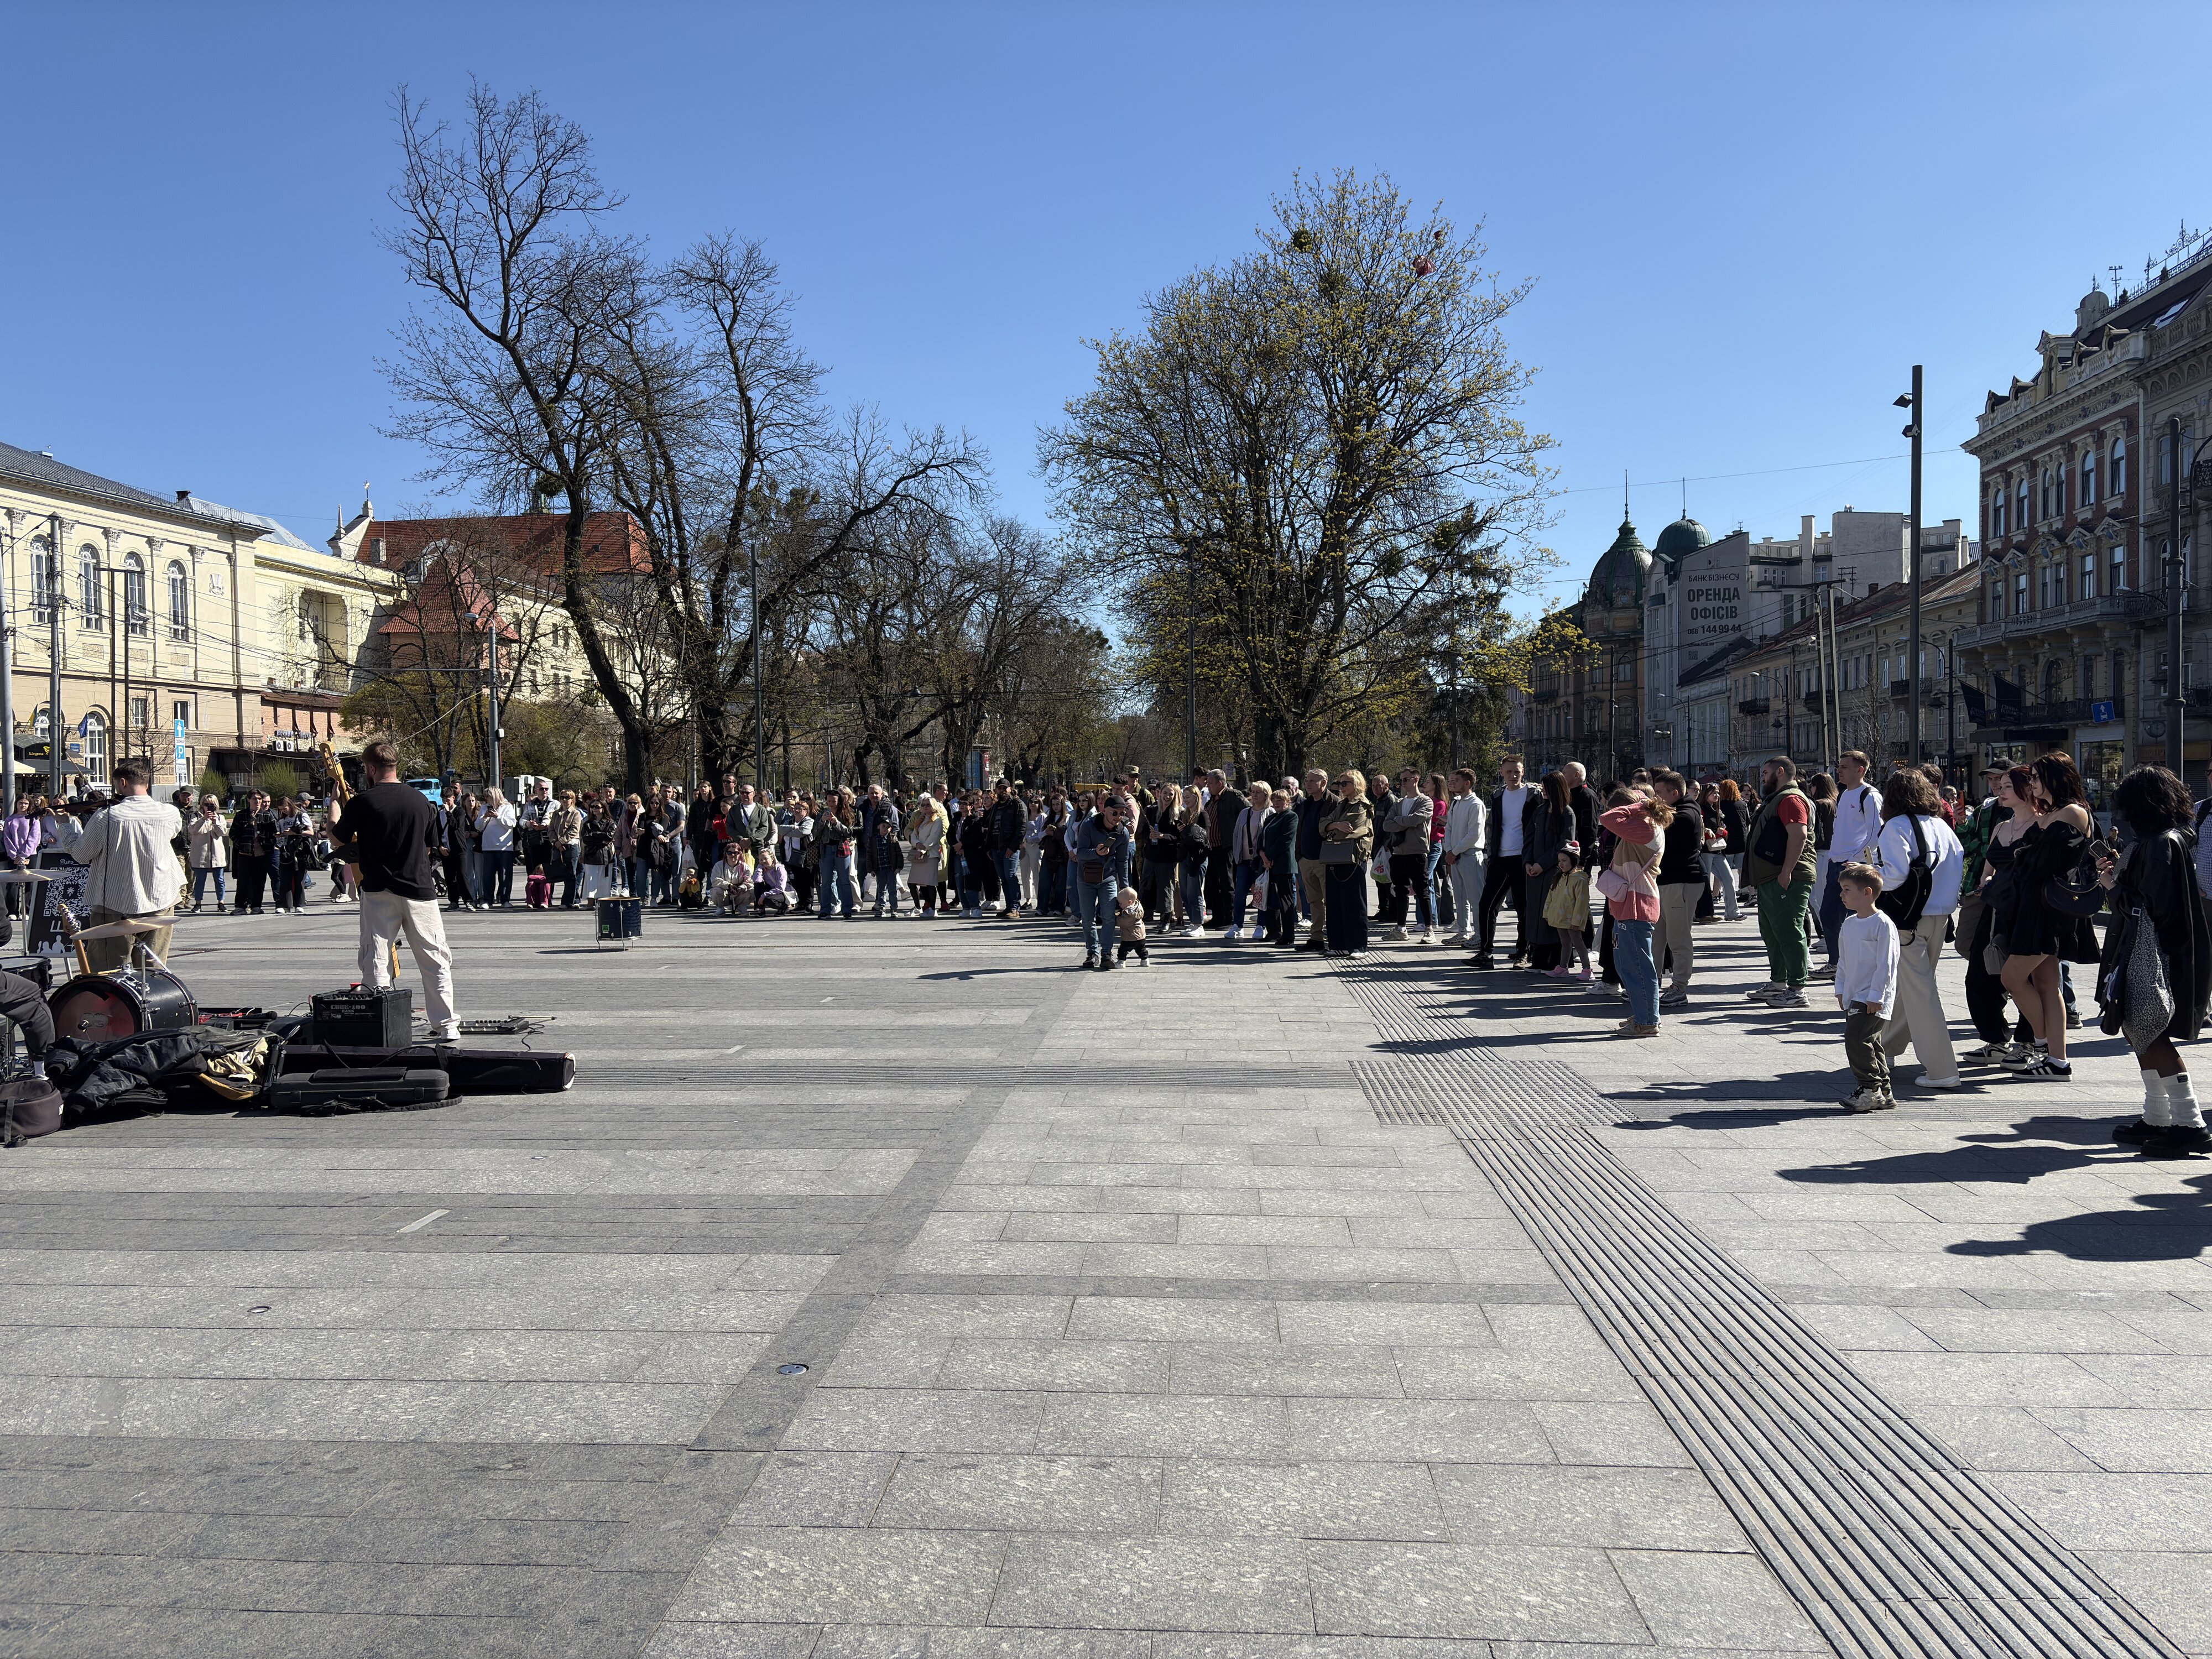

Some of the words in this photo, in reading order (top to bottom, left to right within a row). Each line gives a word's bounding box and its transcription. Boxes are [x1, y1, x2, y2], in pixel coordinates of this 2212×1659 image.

[1687, 587, 1741, 603] ОРЕНДА
[1691, 606, 1738, 620] ОФІСІВ
[1700, 624, 1717, 634] 144
[1718, 624, 1729, 633] 99
